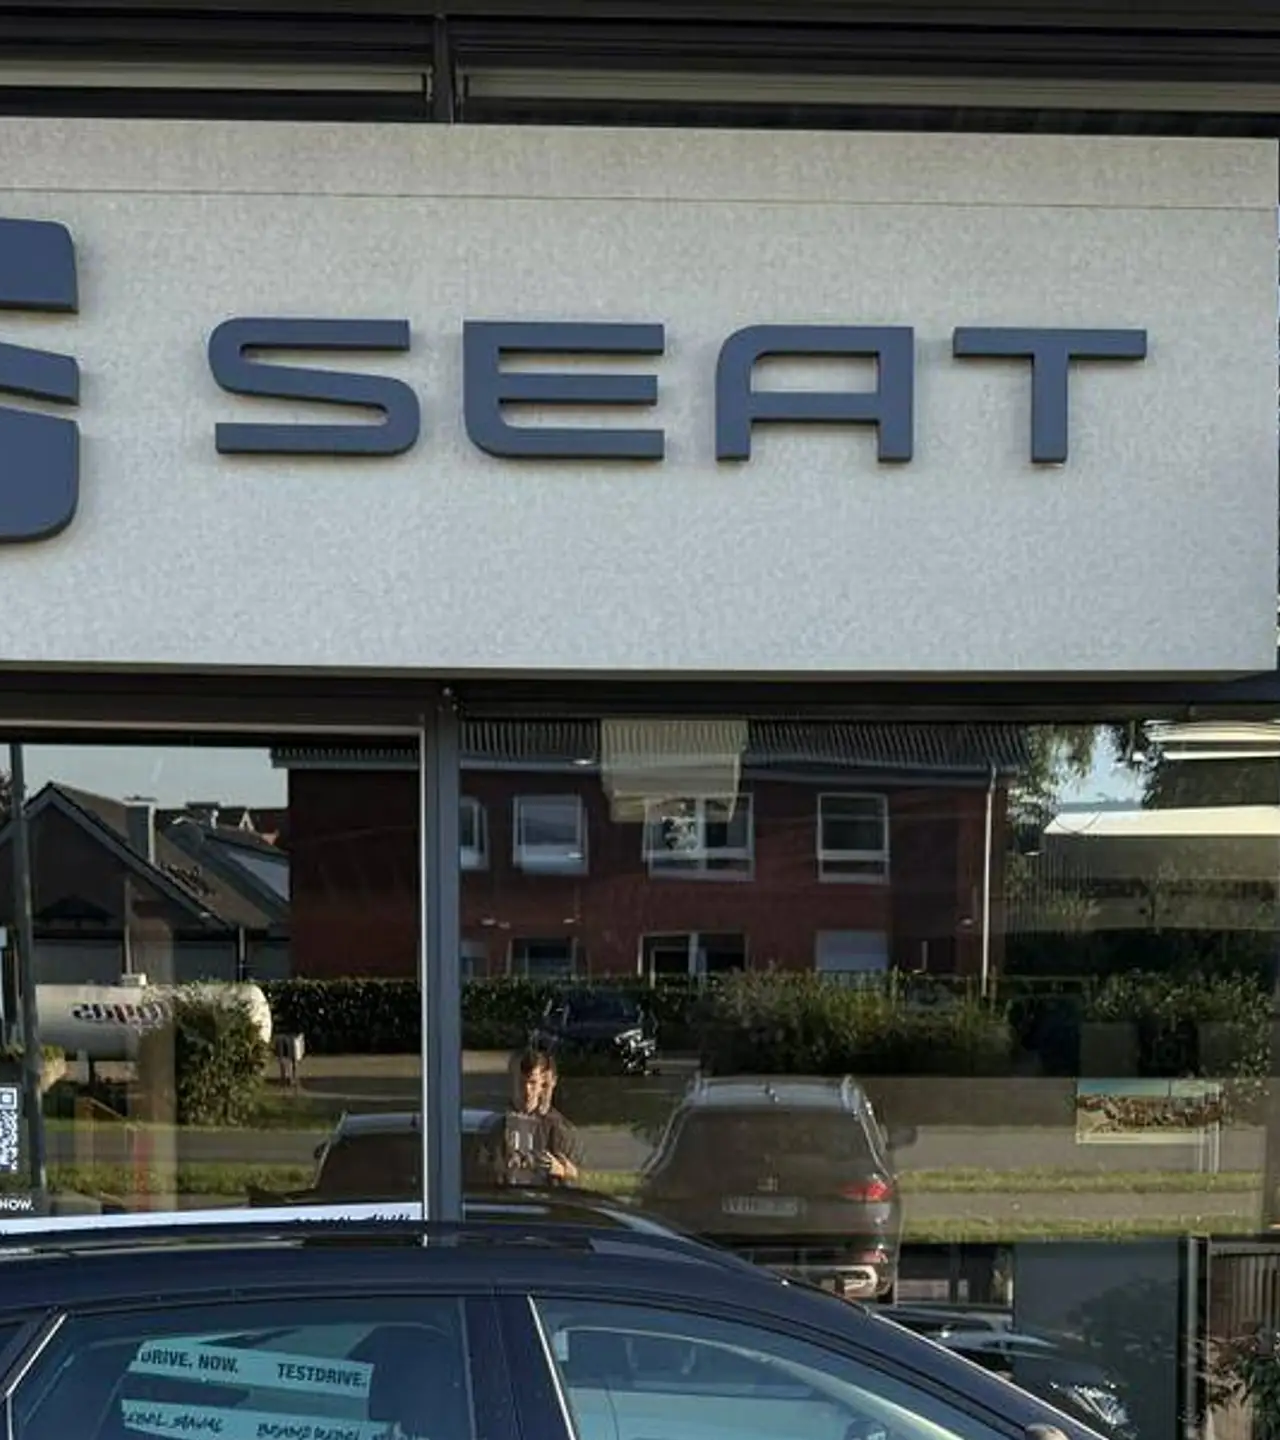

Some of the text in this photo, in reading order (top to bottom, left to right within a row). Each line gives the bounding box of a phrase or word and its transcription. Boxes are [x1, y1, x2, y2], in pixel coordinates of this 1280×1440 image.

[207, 316, 1147, 465] SEAT
[0, 1197, 34, 1211] NOW.
[198, 1354, 239, 1374] NOW.
[277, 1362, 367, 1388] TESTDRIVE.
